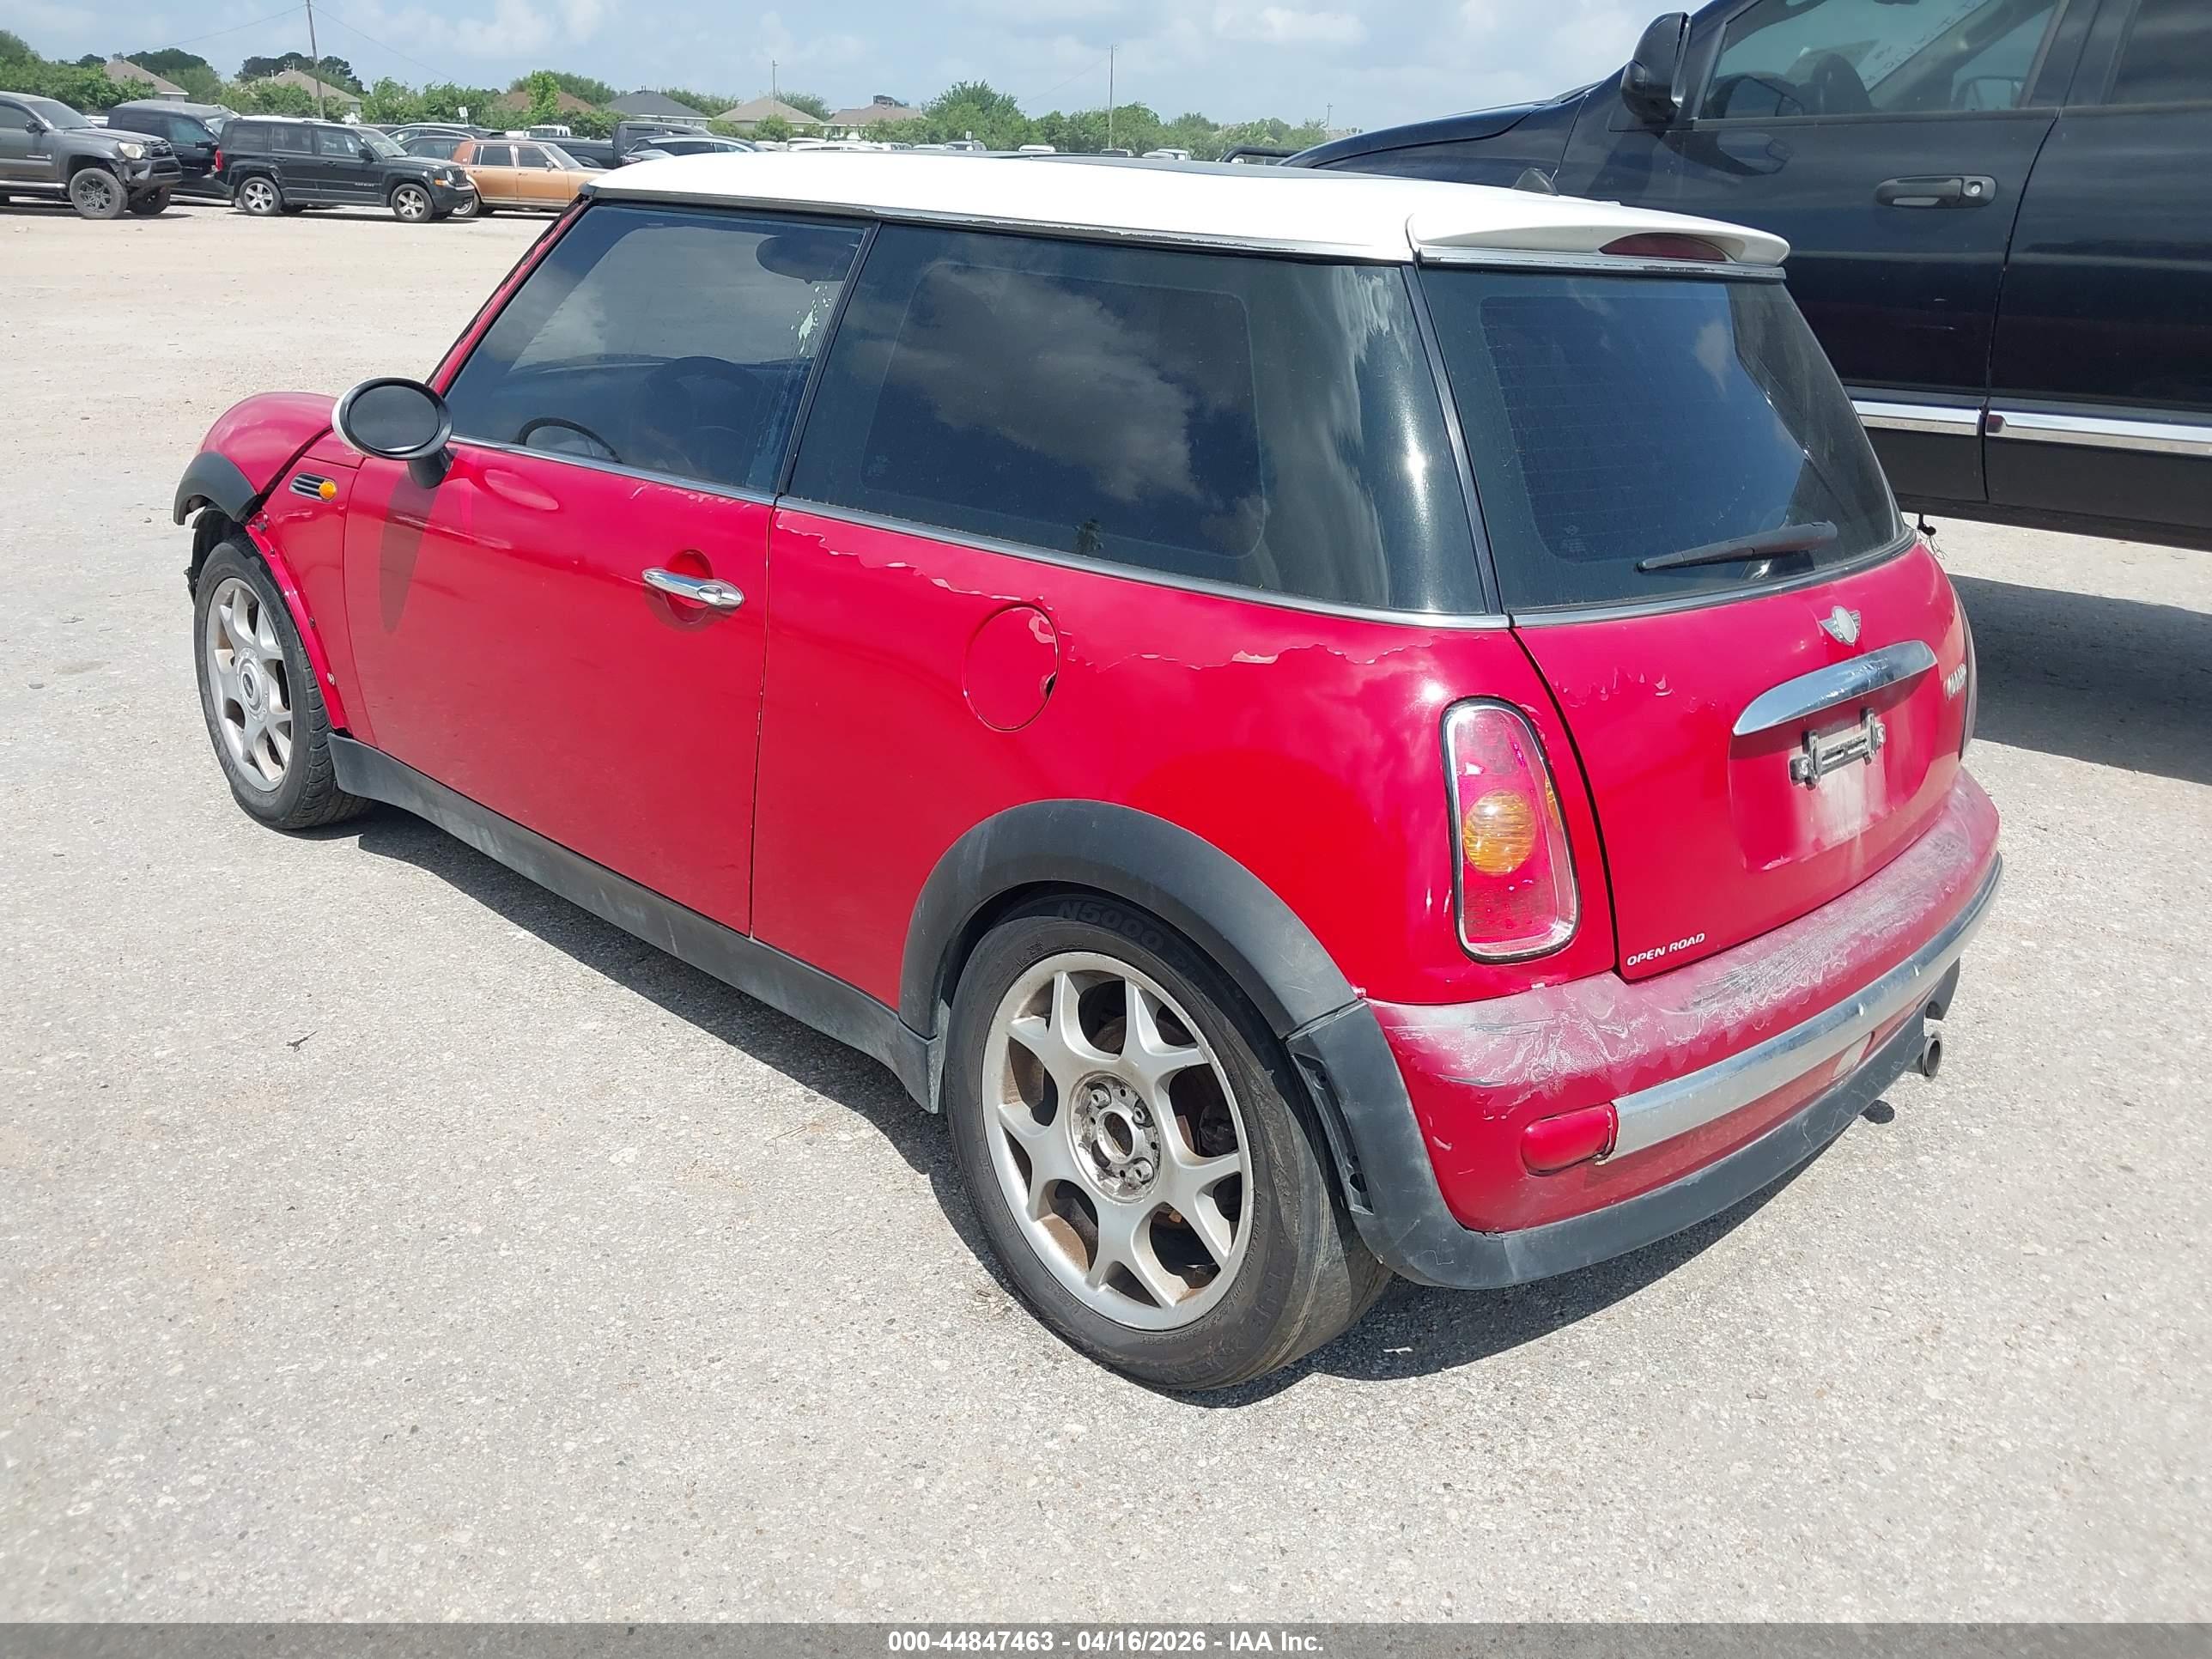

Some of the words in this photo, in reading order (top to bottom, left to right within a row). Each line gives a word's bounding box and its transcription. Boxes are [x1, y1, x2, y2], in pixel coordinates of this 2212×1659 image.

[1057, 902, 1164, 951] N5000
[1626, 946, 1666, 966] OPEN
[1668, 933, 1705, 952] ROAD
